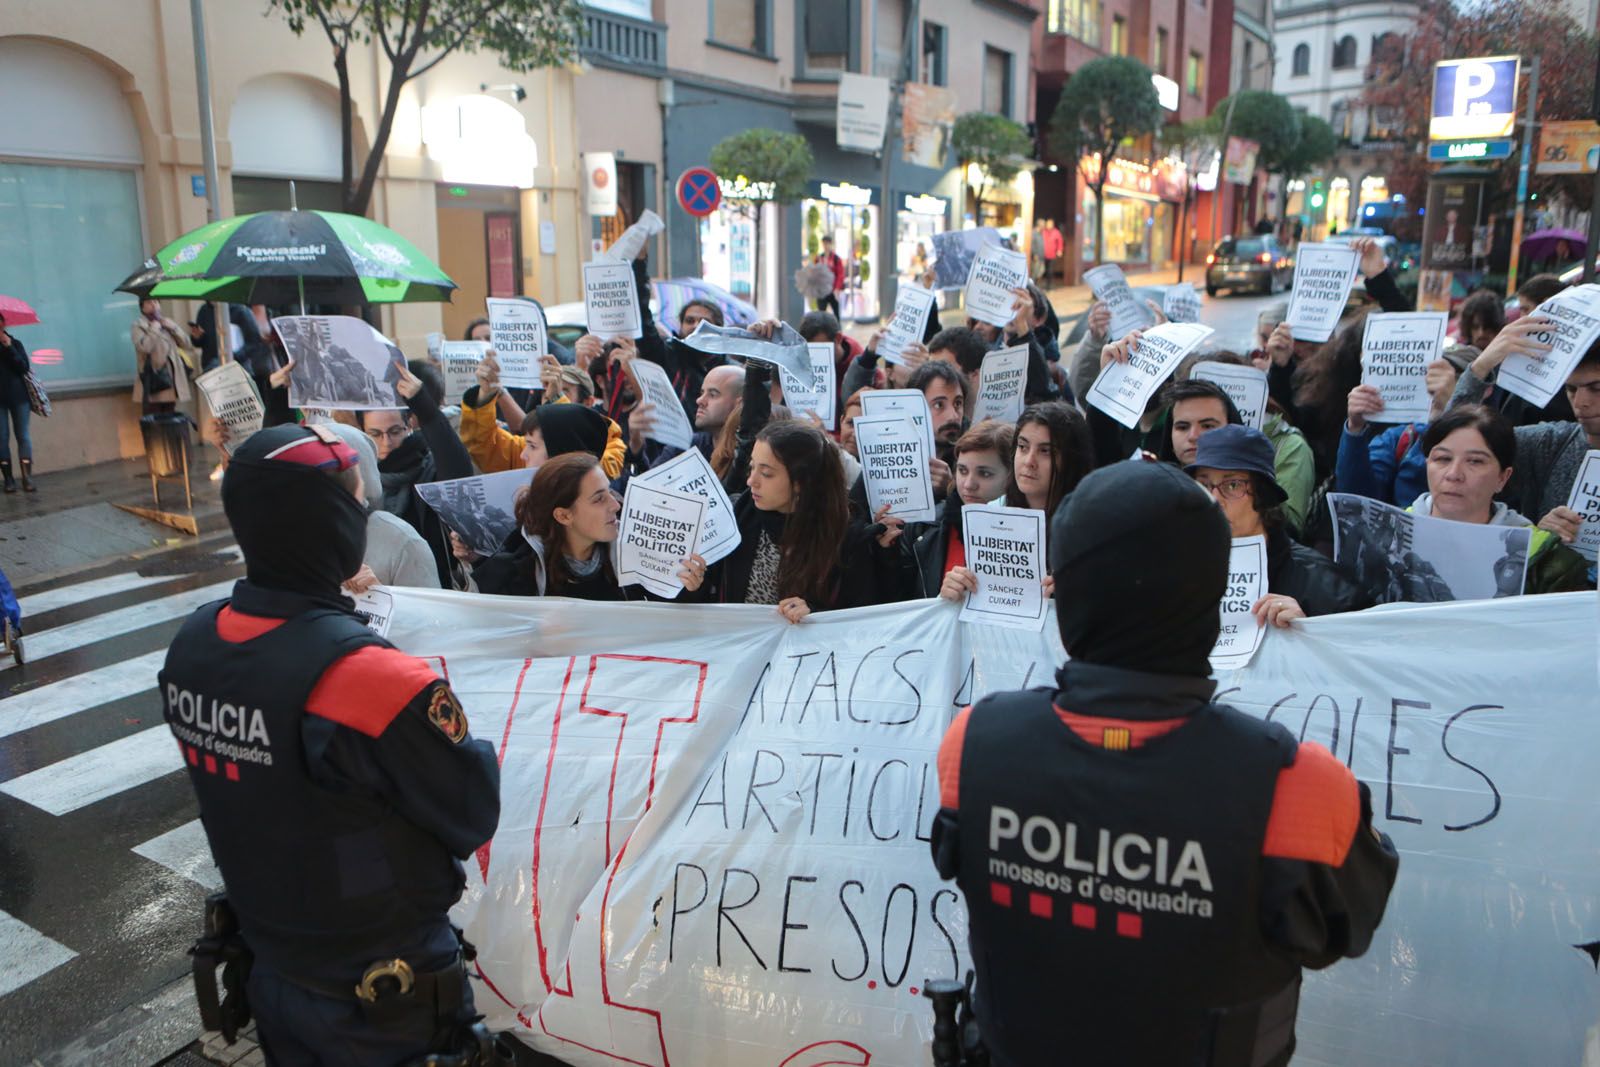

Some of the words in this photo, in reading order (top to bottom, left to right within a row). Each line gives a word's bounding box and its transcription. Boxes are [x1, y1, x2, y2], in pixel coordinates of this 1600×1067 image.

[1452, 62, 1495, 117] P
[237, 245, 326, 257] Kawasaki
[285, 253, 316, 262] Team
[977, 257, 1022, 280] LLIBERTAT
[1300, 267, 1349, 280] LLIBERTAT
[588, 280, 630, 291] LLIBERTAT
[1302, 279, 1341, 290] PRESOS
[593, 290, 628, 300] PRESOS
[491, 323, 538, 331] LLIBERTAT
[494, 333, 534, 342] PRESOS
[1367, 340, 1434, 351] LLIBERTAT
[1372, 353, 1425, 364] PRESOS
[984, 368, 1024, 383] LLIBERTAT
[1368, 363, 1428, 377] POLÍTICS
[986, 380, 1019, 392] PRESOS
[863, 442, 919, 455] LLIBERTAT
[870, 455, 913, 467] PRESOS
[869, 466, 918, 480] POLÍTICS
[628, 508, 695, 533] LLIBERTAT
[632, 523, 686, 543] PRESOS
[627, 534, 687, 556] POLÍTICS
[971, 535, 1035, 553] LLIBERTAT
[977, 549, 1029, 566] PRESOS
[641, 560, 670, 576] CUIXART
[974, 562, 1035, 580] POLÍTICS
[988, 583, 1025, 596] SÁNCHEZ
[988, 595, 1022, 607] CUIXART
[167, 682, 271, 747] POLICIA
[988, 804, 1214, 892] POLICIA
[989, 856, 1072, 894] mossos
